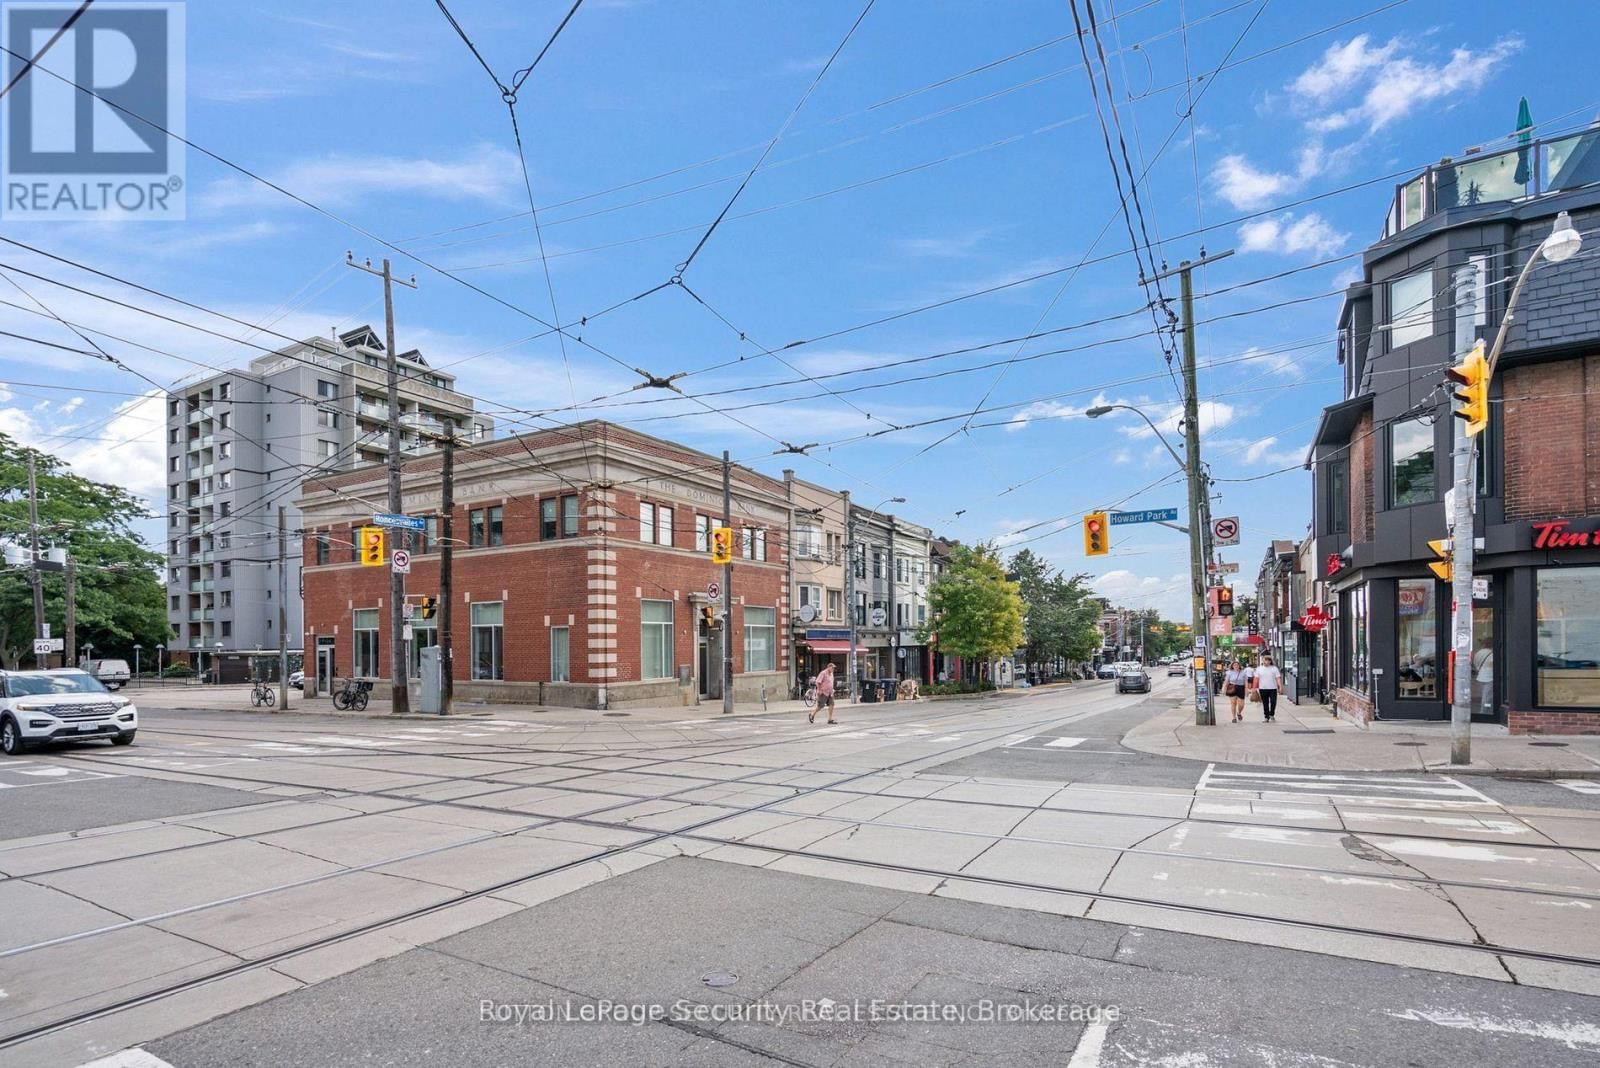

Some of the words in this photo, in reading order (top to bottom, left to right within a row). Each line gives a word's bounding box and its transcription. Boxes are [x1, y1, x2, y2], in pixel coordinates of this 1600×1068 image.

[462, 482, 495, 497] BANK
[687, 489, 725, 507] DOMINIO
[1111, 512, 1144, 524] Howard
[1147, 510, 1168, 521] Park
[1532, 520, 1589, 548] Tim
[1303, 614, 1328, 626] Tims
[36, 644, 50, 652] 40
